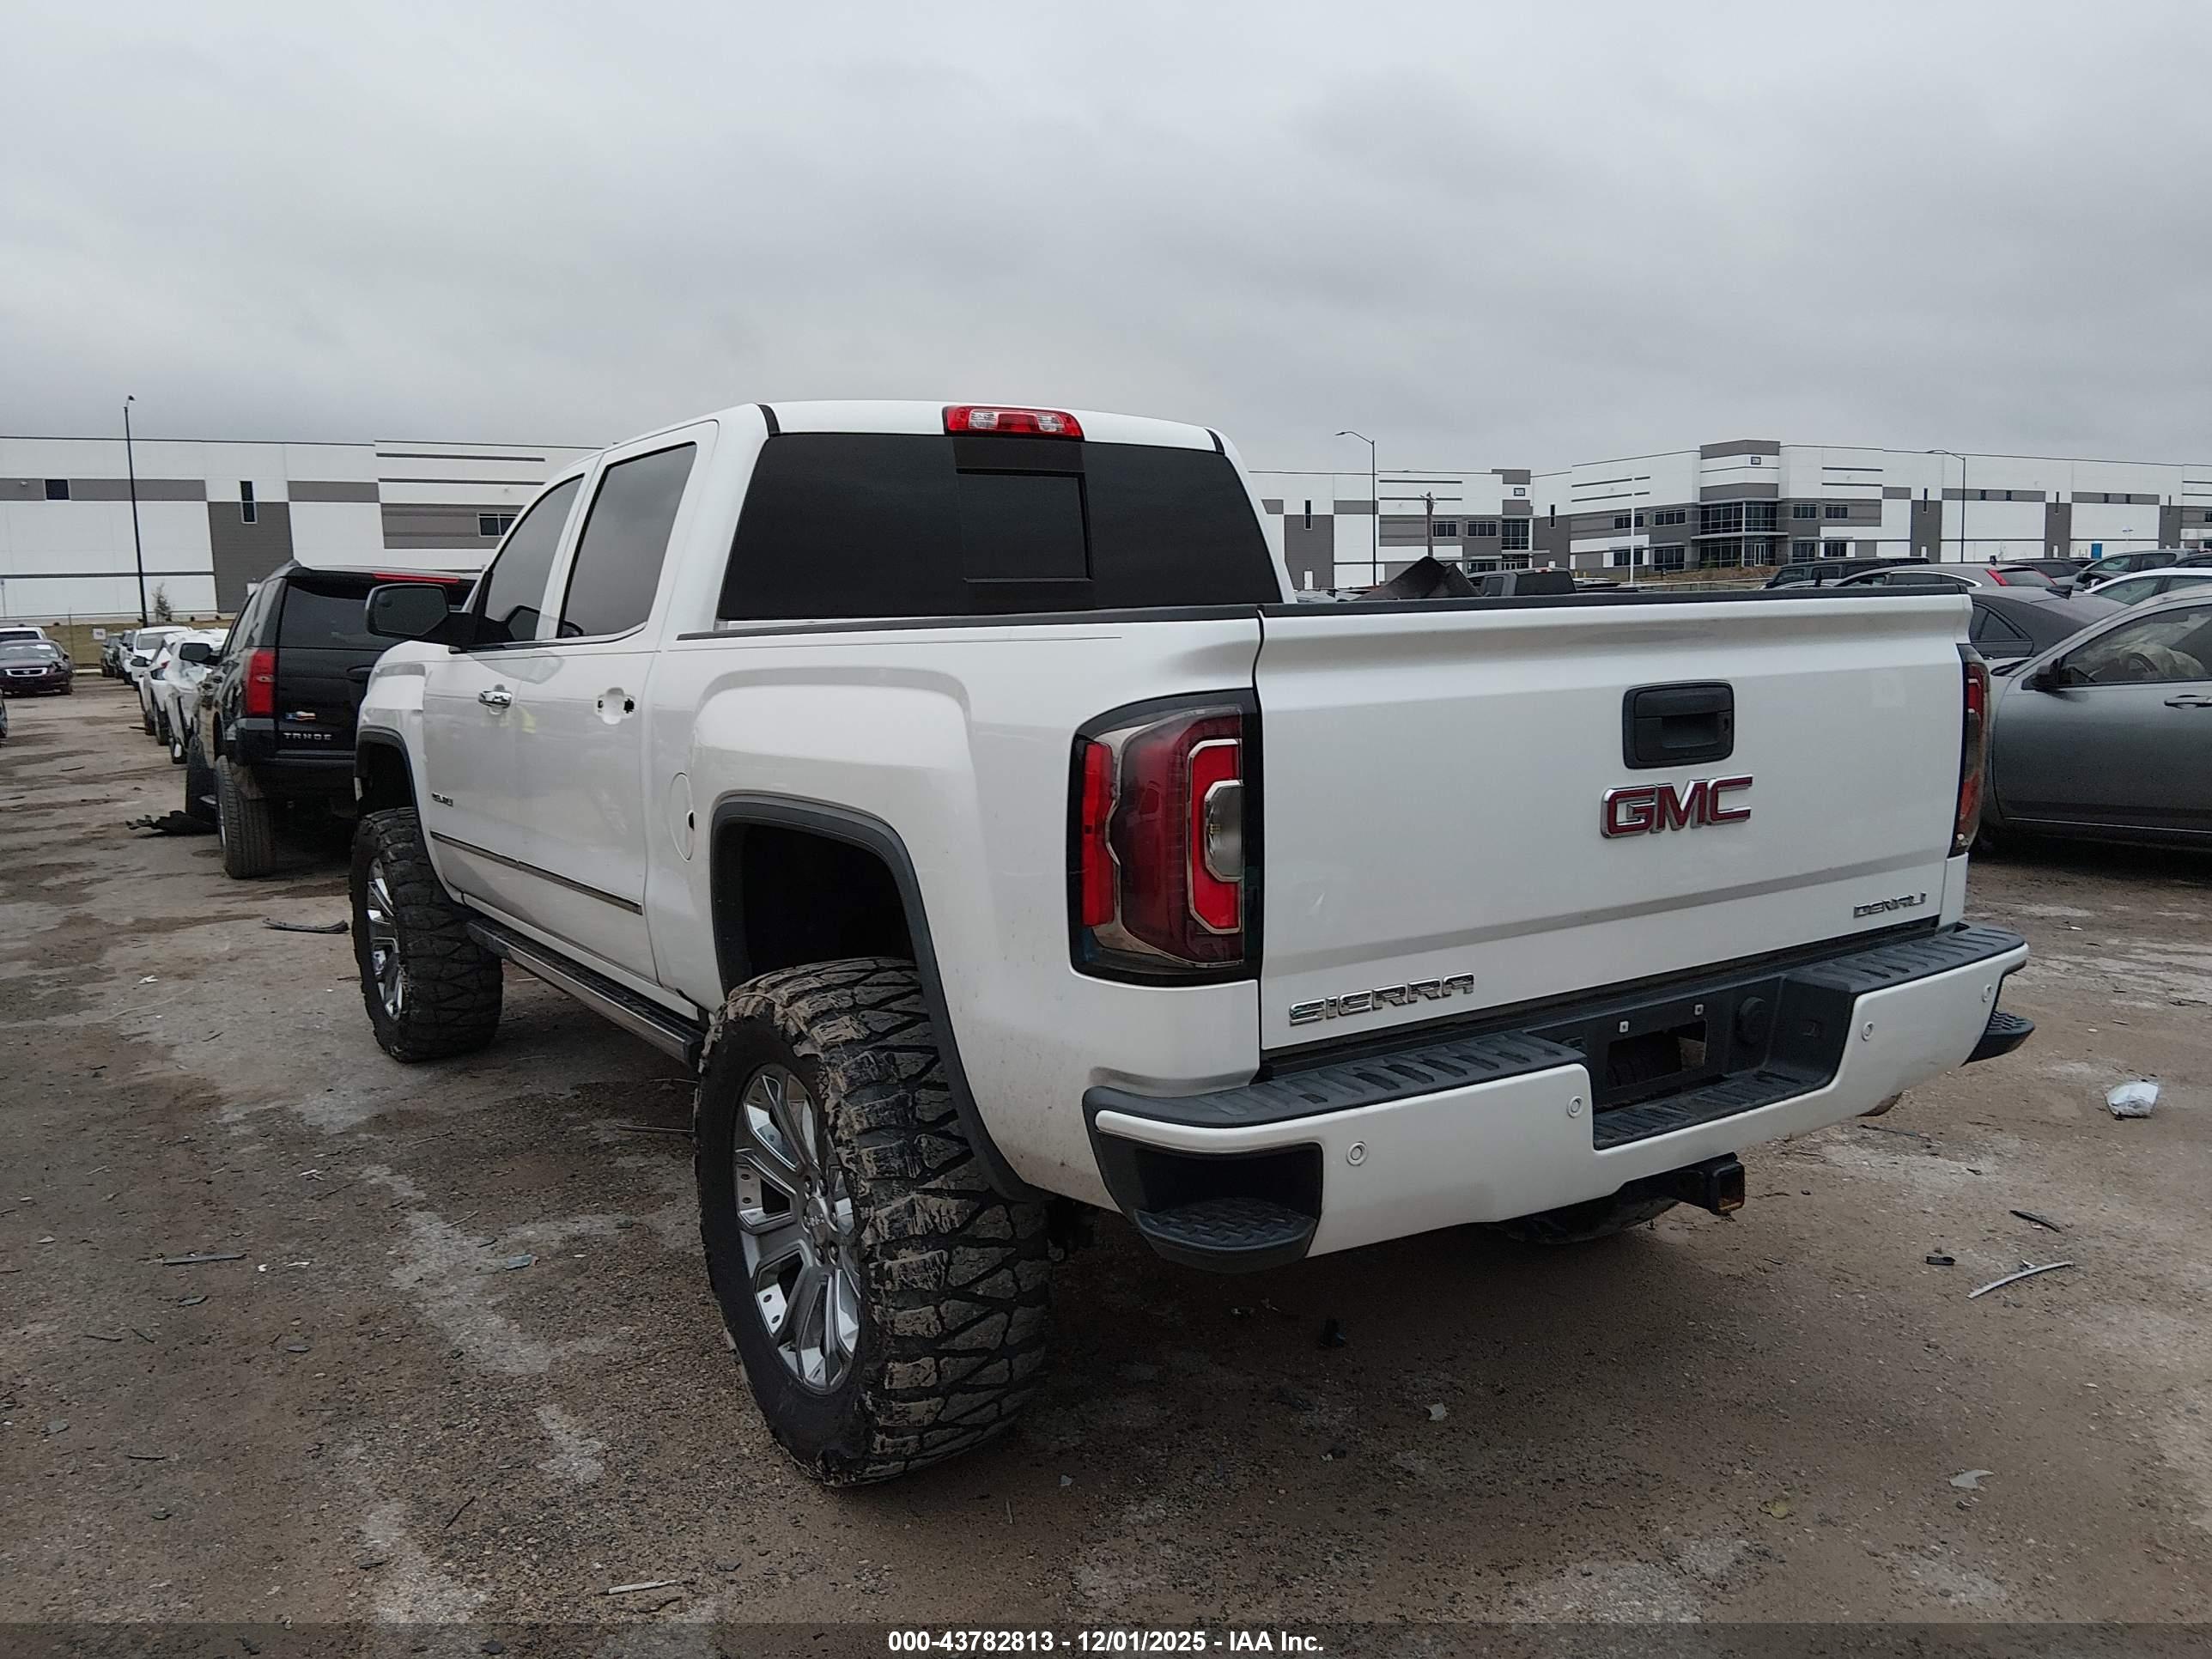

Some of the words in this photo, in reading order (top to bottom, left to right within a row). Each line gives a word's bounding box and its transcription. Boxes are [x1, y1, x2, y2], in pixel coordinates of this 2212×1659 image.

[1601, 774, 1753, 839] GMC
[1853, 891, 1927, 919] DENALI
[1290, 972, 1474, 1027] SIERRA
